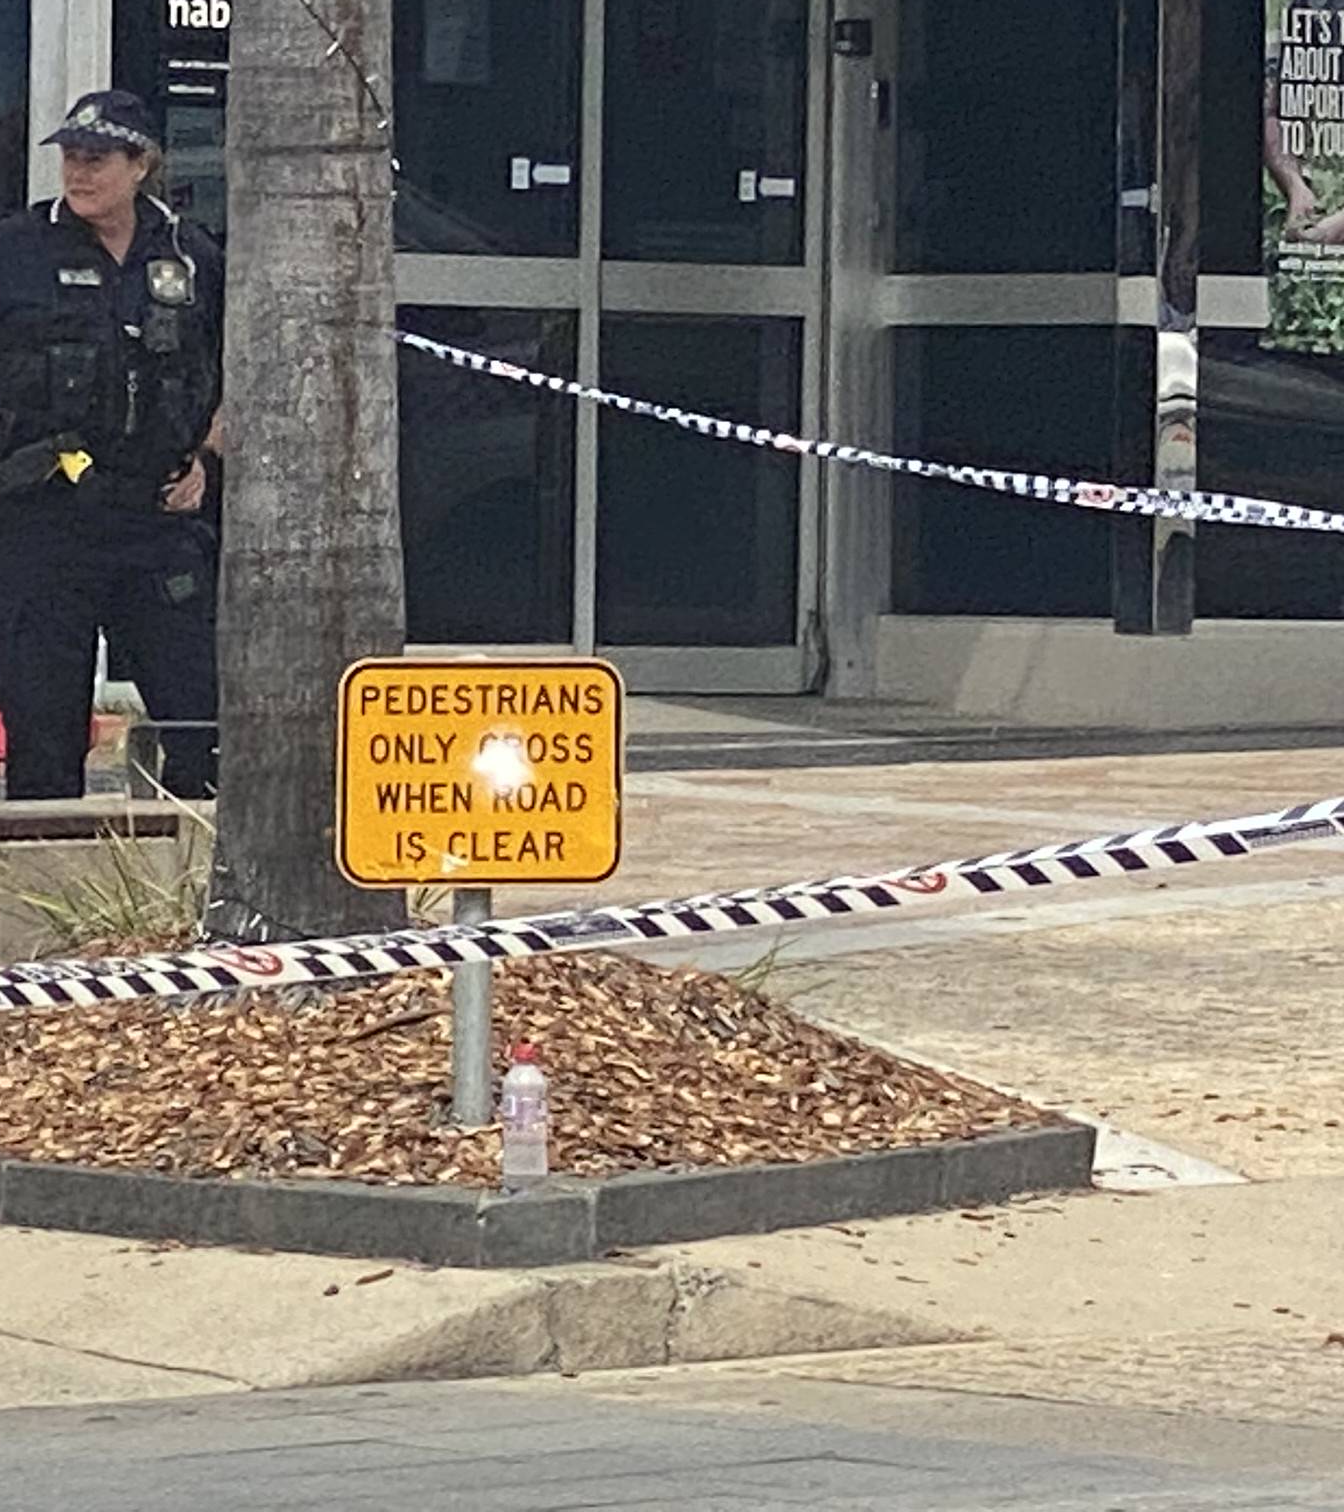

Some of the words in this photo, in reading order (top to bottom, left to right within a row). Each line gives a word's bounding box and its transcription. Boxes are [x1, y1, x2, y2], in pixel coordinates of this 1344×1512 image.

[1282, 9, 1331, 44] LET'S
[1281, 46, 1344, 81] ABOUT
[1281, 121, 1307, 155] TO
[361, 684, 604, 716] PEDESTRIANS
[370, 733, 456, 764] ONLY
[377, 782, 472, 814] WHEN
[492, 782, 587, 813] ROAD
[395, 831, 427, 863] IS
[448, 831, 565, 862] CLEAR
